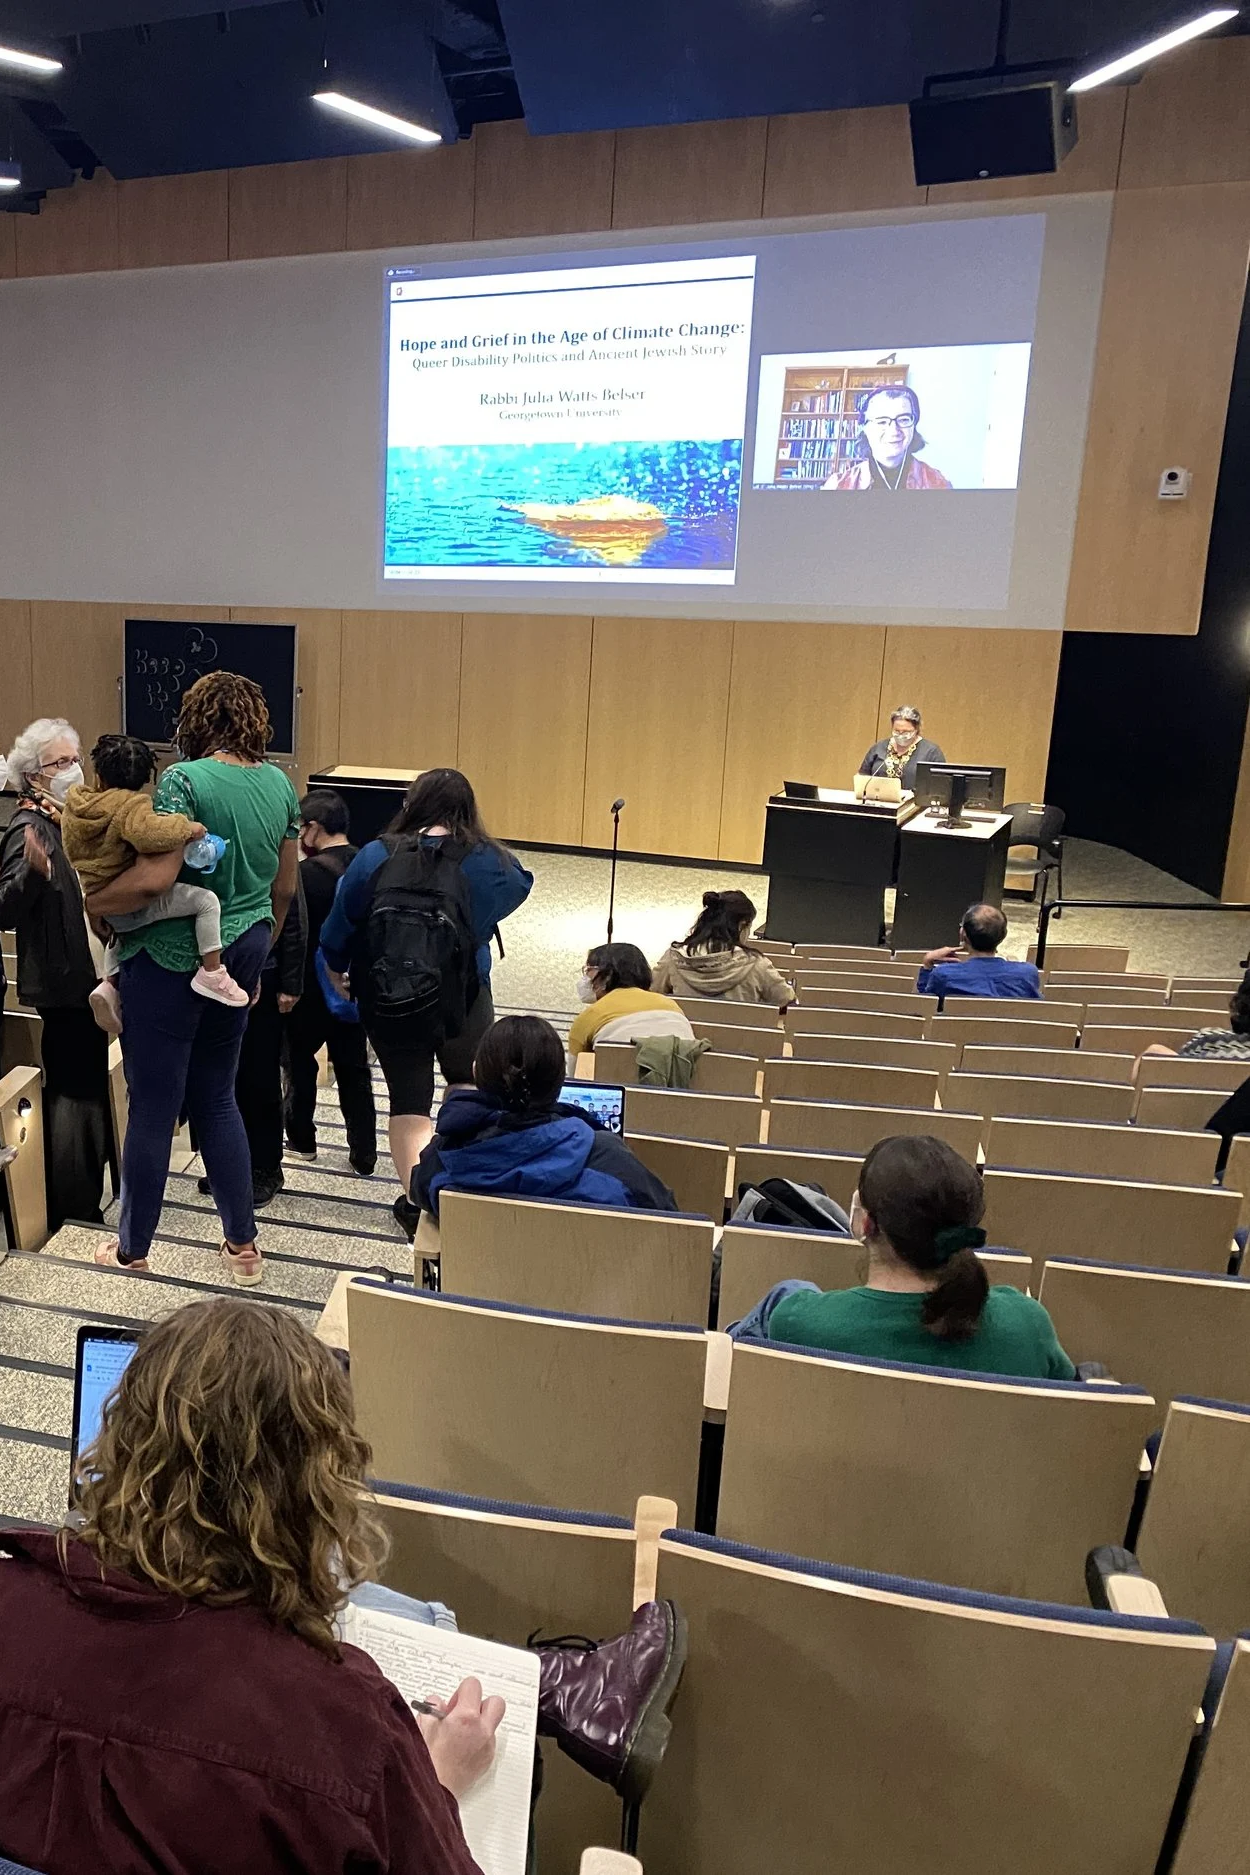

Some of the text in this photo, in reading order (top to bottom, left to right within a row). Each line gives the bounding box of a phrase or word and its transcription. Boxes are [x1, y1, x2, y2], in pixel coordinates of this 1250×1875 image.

[400, 322, 746, 353] Hope and Grief in the Age of Climate Change:
[412, 344, 727, 372] Queer Disability Politics and Ancient Jewish Story
[479, 388, 647, 406] Rabbi Julia Watts Belser
[499, 408, 623, 422] Georgetown University
